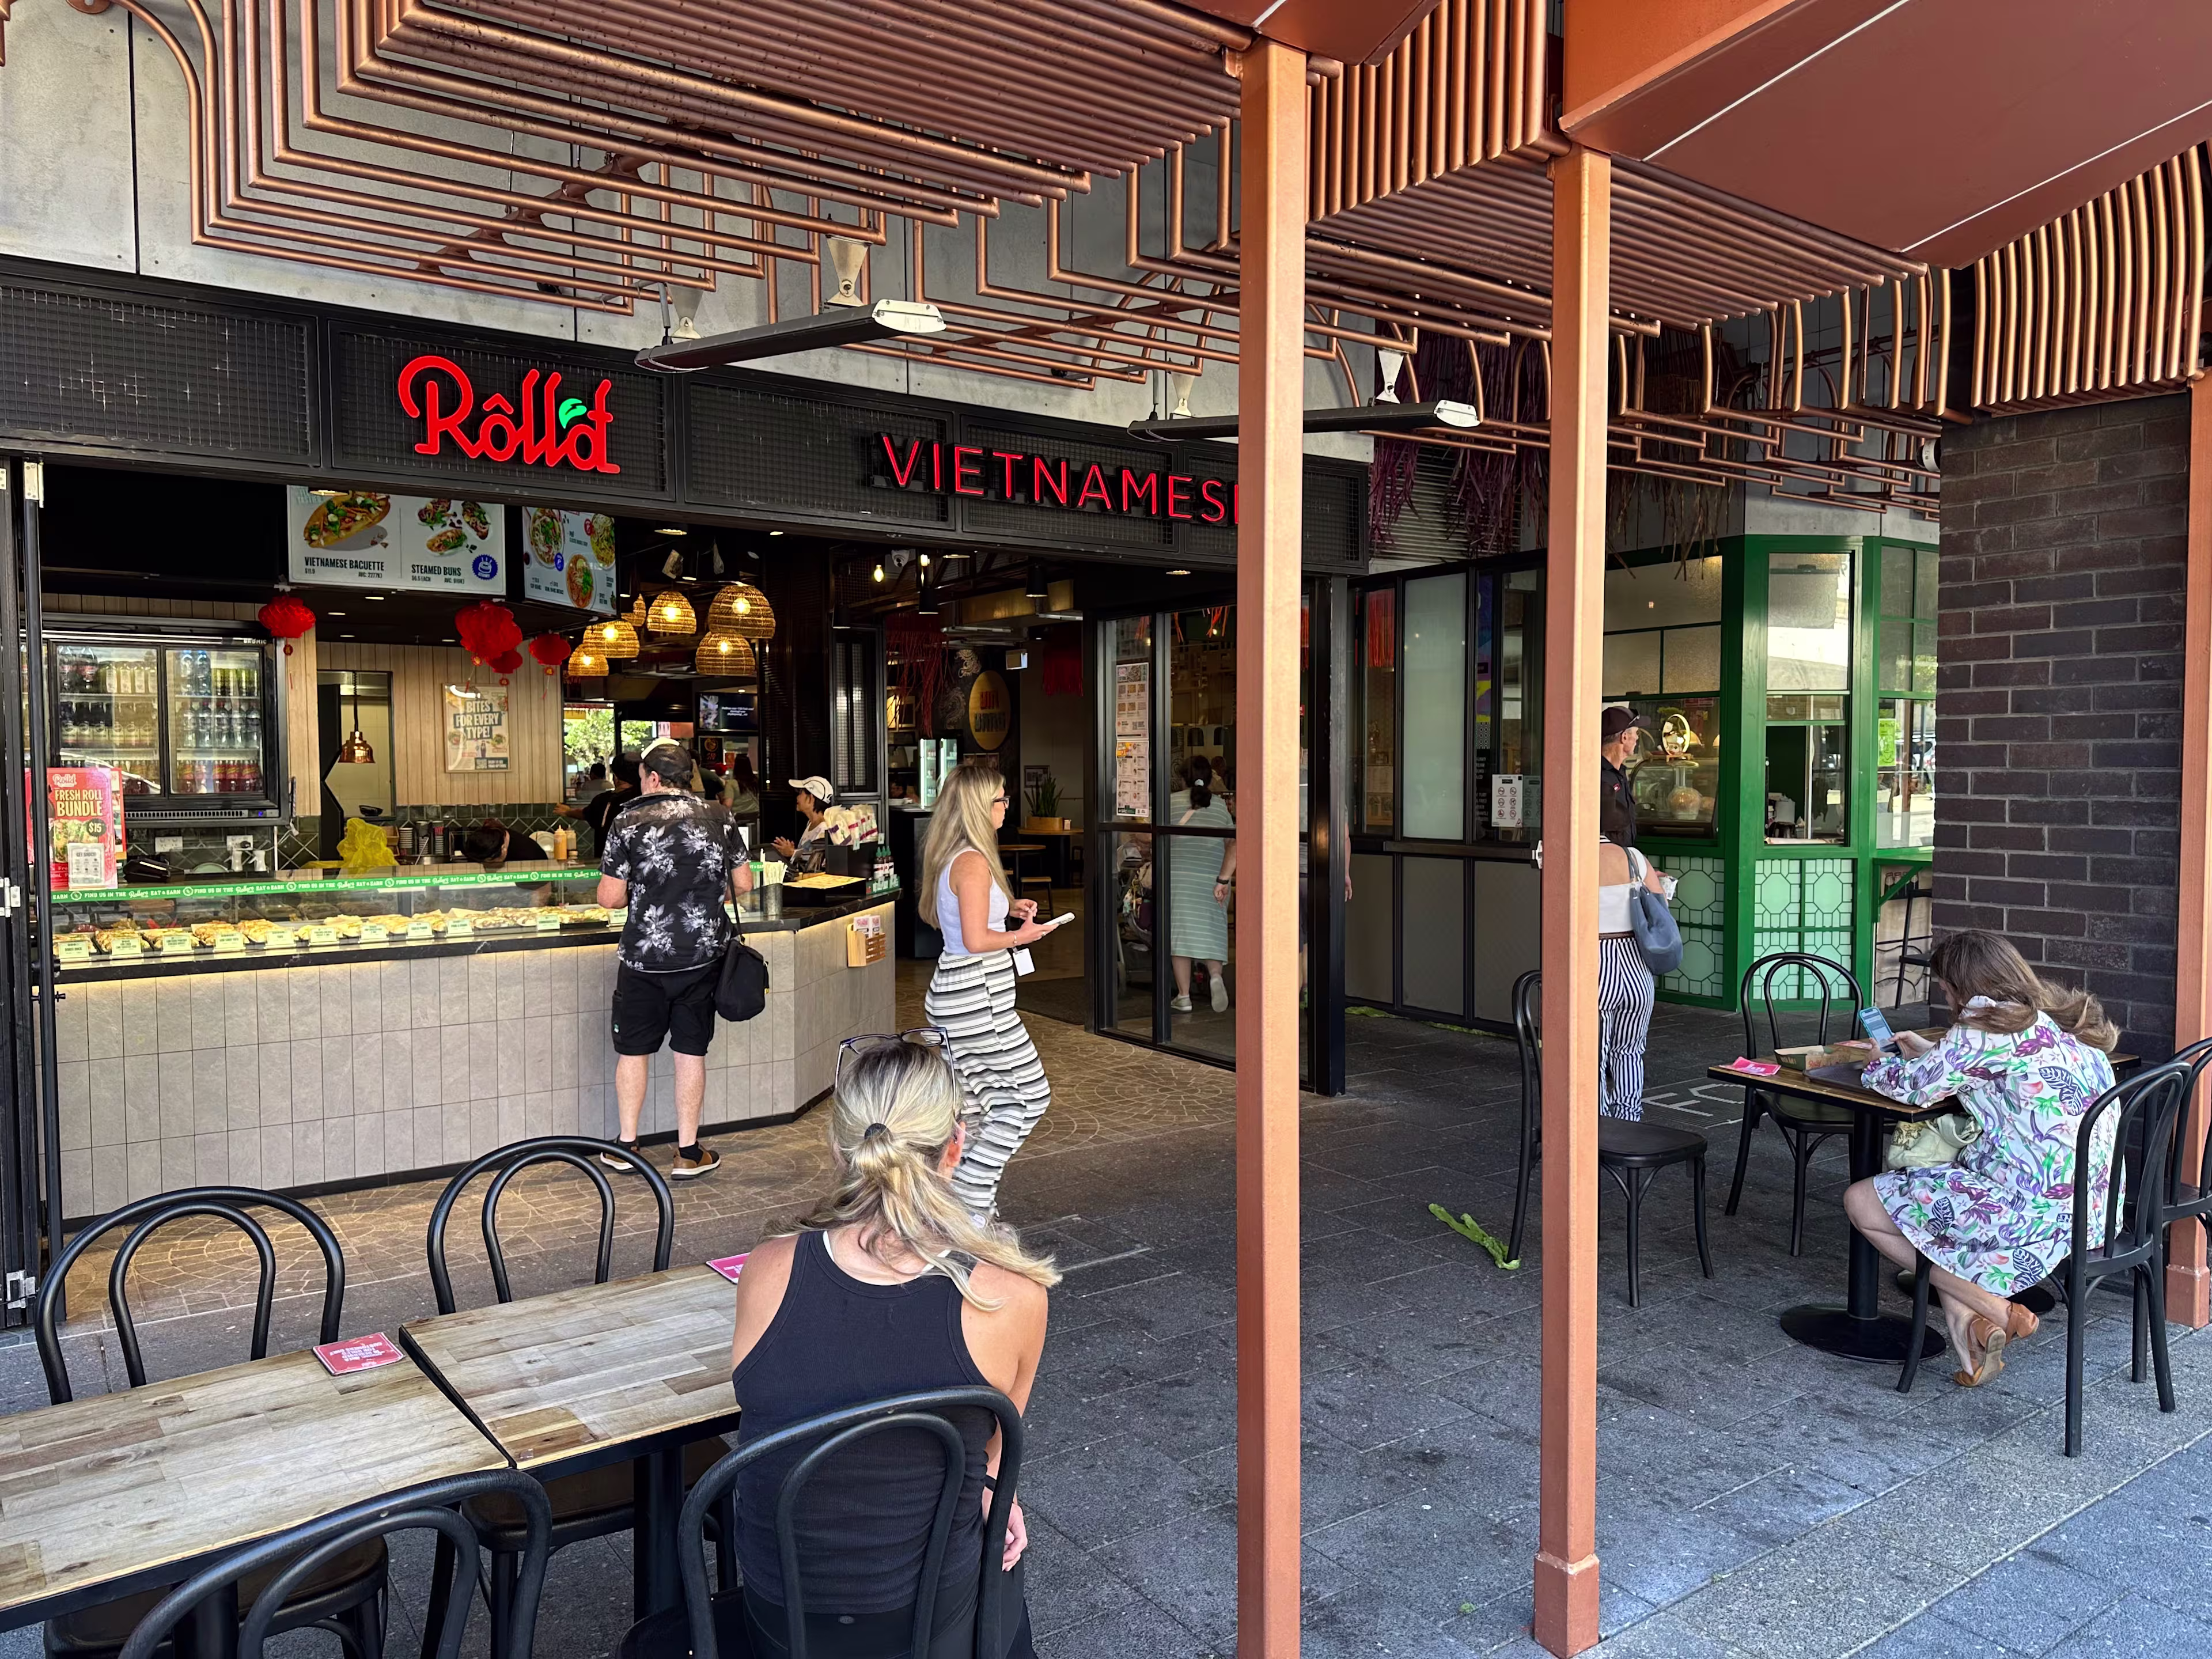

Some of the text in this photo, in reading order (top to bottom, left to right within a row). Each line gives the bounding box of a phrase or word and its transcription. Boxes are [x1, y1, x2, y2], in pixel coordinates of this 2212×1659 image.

[876, 432, 1239, 524] VIETNAMES
[304, 556, 384, 571] VIETNAMESE BAGUETTE
[411, 564, 461, 577] STEAMED BUNS
[466, 701, 491, 713] BITES
[456, 713, 499, 726] FOR EVERY
[466, 726, 490, 738] TYPE!
[55, 789, 103, 801] FRESH ROLL
[56, 801, 103, 816] BUNDLE
[88, 822, 102, 833] $15
